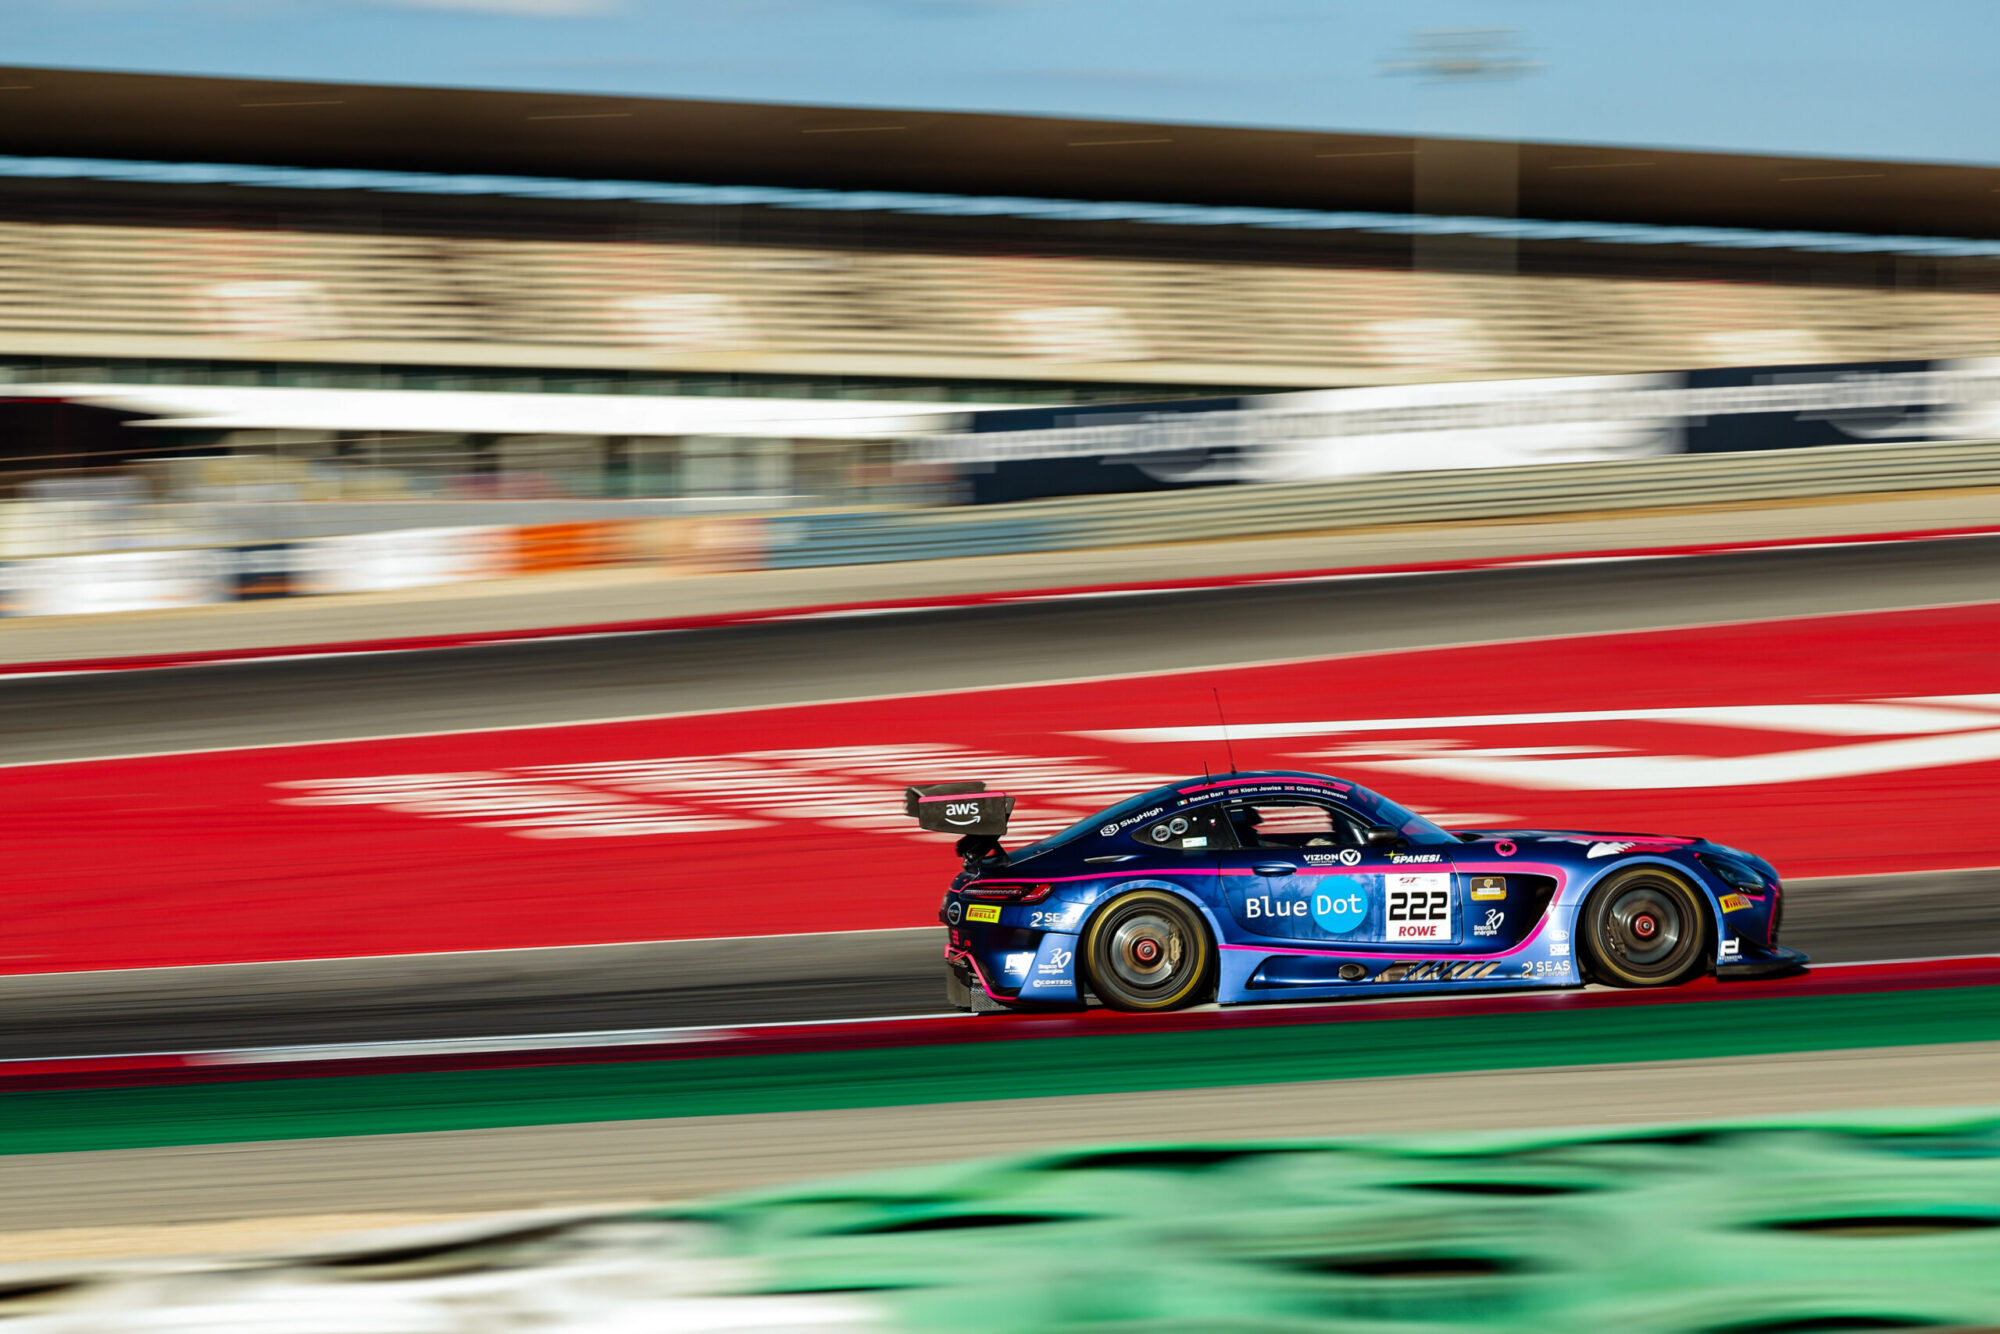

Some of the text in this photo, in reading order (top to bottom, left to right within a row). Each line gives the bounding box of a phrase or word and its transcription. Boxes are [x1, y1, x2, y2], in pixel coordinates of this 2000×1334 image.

[1210, 791, 1224, 799] Barr
[1296, 785, 1321, 794] Charles
[1322, 789, 1348, 800] Dawson
[945, 802, 980, 816] aws
[1303, 853, 1339, 862] VIZION
[1246, 893, 1363, 918] Blue Dot
[1388, 891, 1448, 921] 222
[968, 907, 997, 919] PIRELLI
[1398, 926, 1437, 937] ROWE
[1536, 960, 1571, 973] SEAS
